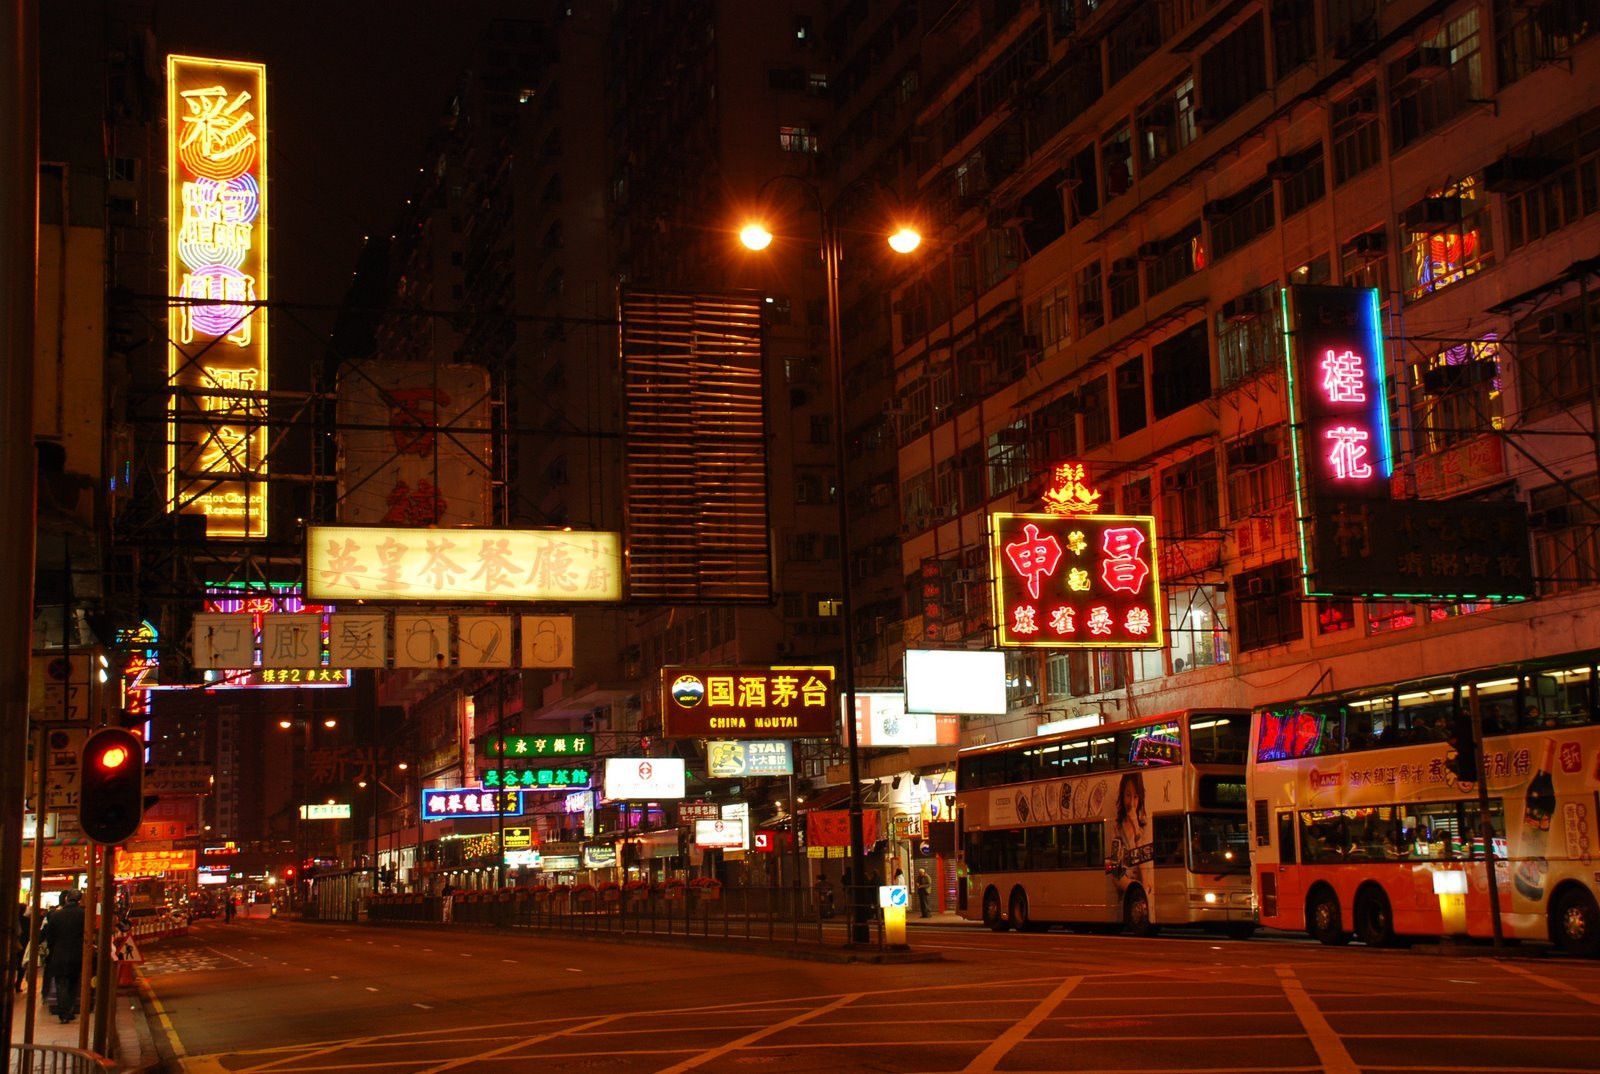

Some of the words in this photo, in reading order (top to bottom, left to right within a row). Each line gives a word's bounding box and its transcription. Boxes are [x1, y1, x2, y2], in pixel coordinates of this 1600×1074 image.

[225, 492, 263, 504] Choce
[204, 505, 259, 516] Restaurnt
[320, 536, 578, 593] 英皇茶餐廳
[707, 675, 828, 708] 国酒茅台
[709, 717, 746, 729] CHINA
[754, 717, 798, 728] MOUTAI
[515, 738, 585, 754] 永亨銀行
[749, 743, 786, 754] STAR
